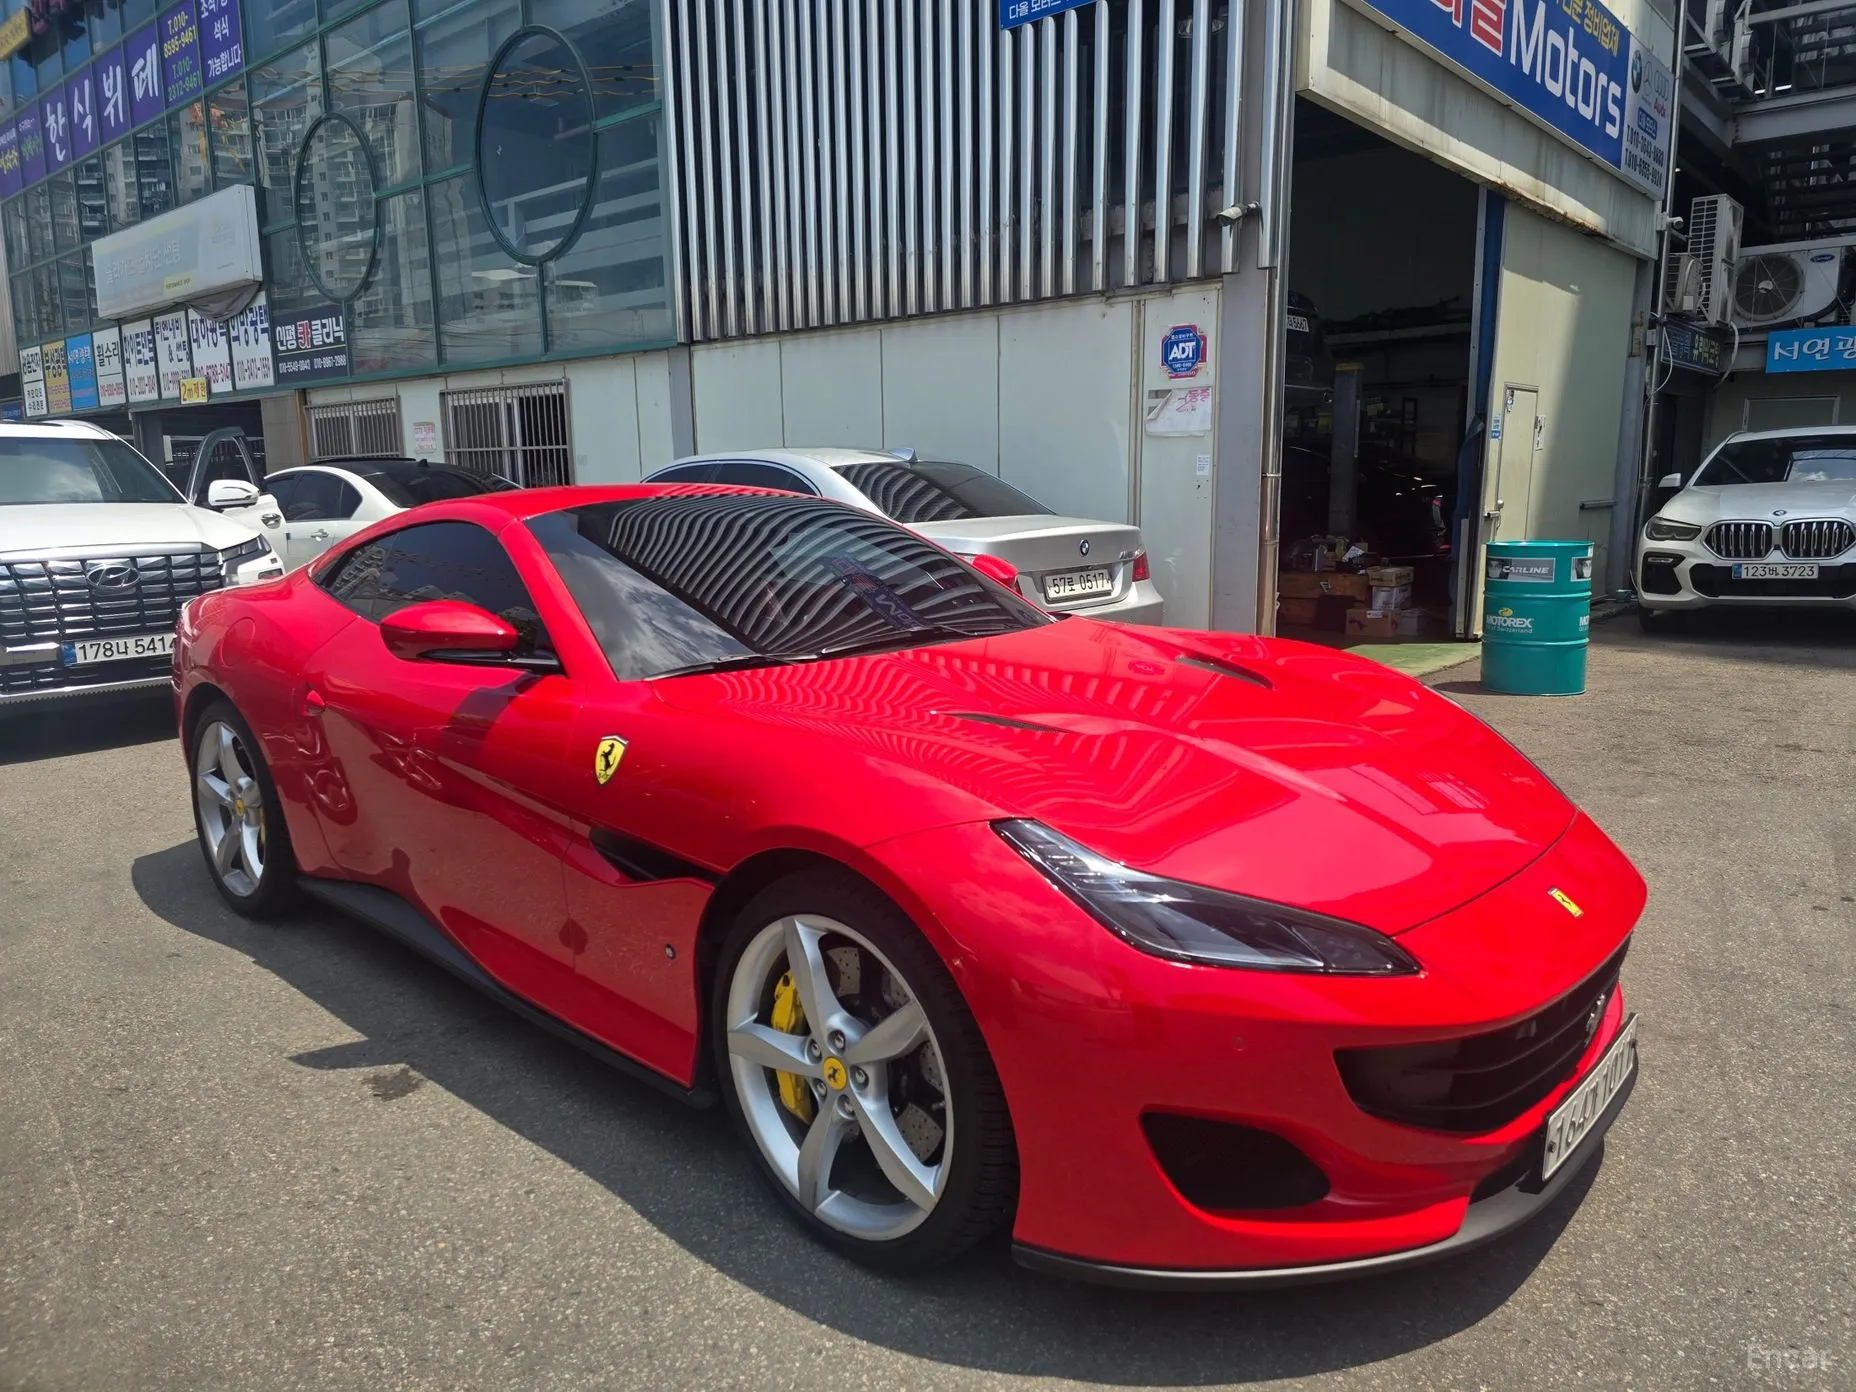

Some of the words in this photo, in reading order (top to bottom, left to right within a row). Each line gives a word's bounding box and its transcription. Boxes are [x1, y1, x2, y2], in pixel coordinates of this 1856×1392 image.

[213, 15, 229, 41] 석식
[207, 43, 241, 78] 가능합니다
[1510, 0, 1622, 139] Motors
[1168, 342, 1196, 360] ADT
[1502, 565, 1550, 574] CARLINE
[1781, 565, 1815, 577] 3723
[1080, 572, 1105, 591] 0517
[1486, 614, 1533, 628] MOTOREX
[78, 640, 129, 661] 178나
